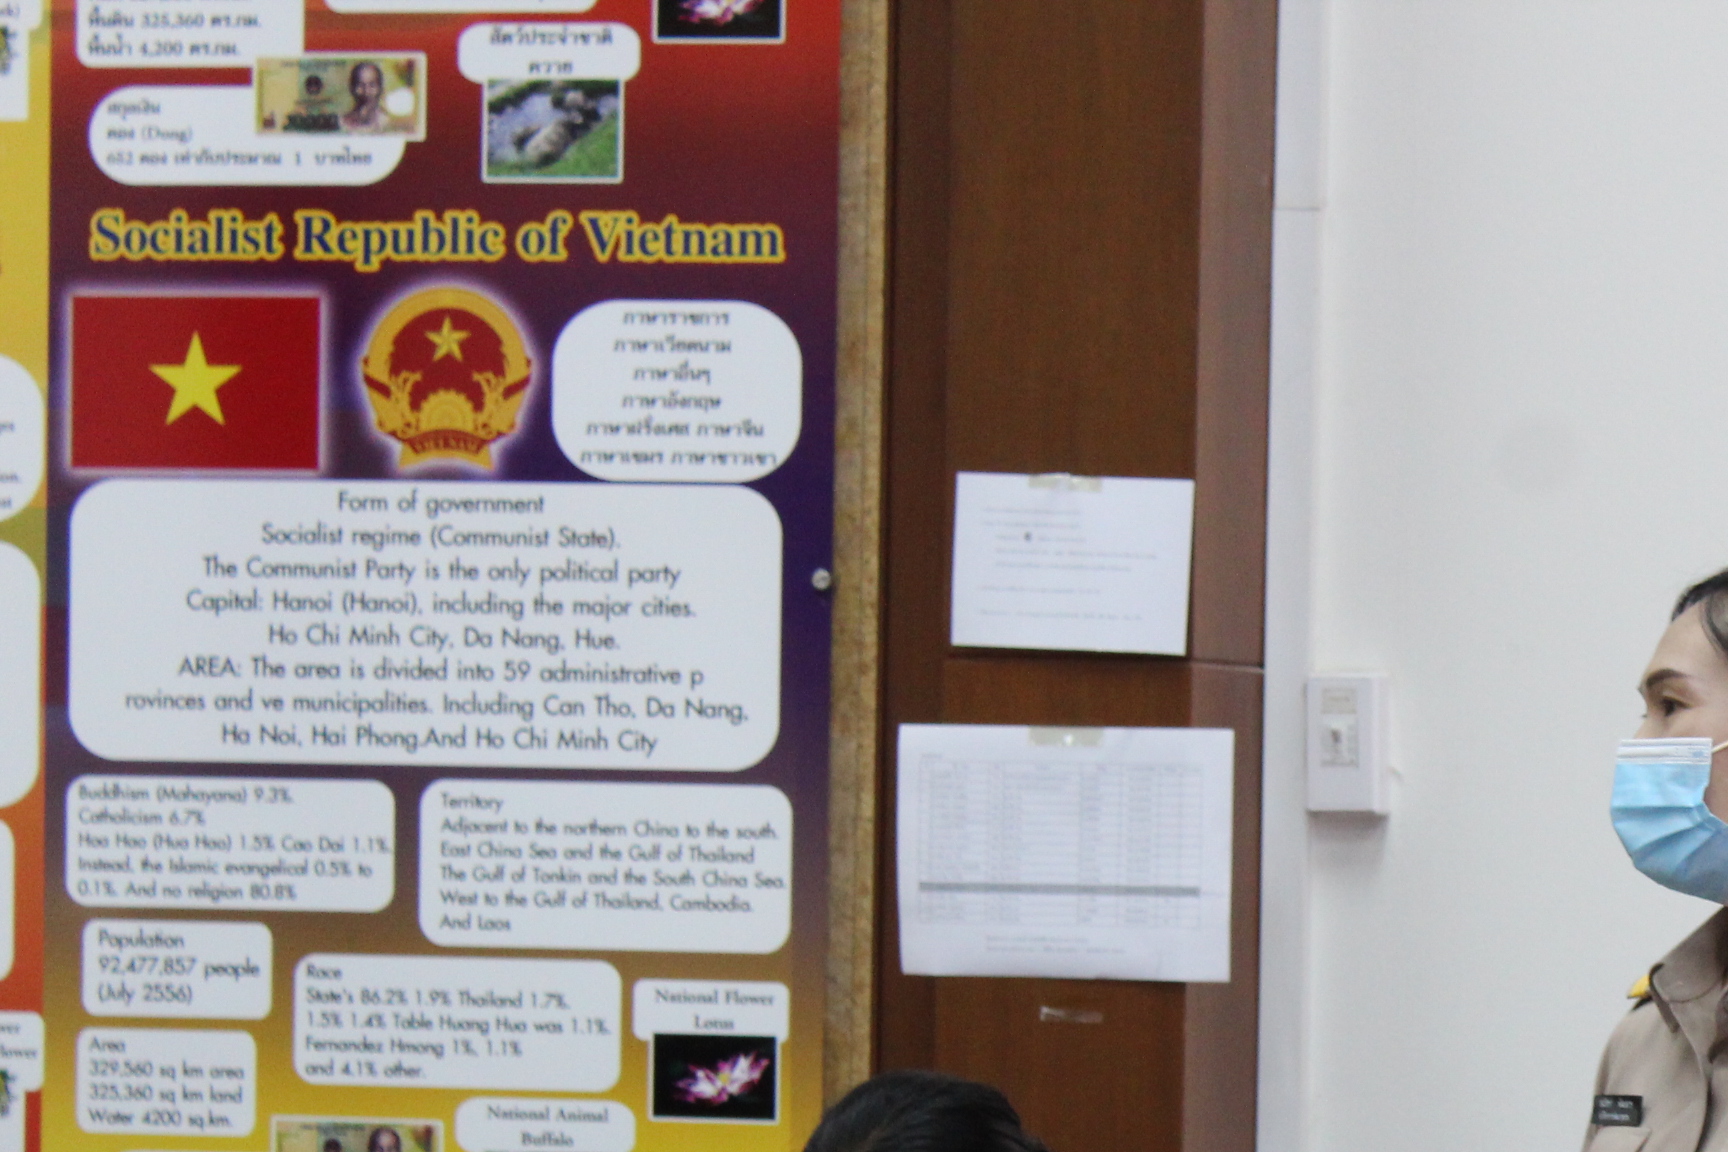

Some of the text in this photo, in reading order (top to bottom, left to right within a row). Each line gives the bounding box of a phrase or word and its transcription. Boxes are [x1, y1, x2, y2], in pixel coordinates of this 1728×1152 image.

[92, 209, 783, 269] Socialist Republic of Vietnam
[337, 489, 545, 520] Form of government
[261, 522, 620, 552] Socialist regime (Communist State).
[203, 554, 681, 589] The Communist Party is the only political party
[186, 587, 262, 617] Capital:
[272, 590, 333, 613] Hanoi
[432, 590, 525, 622] including
[533, 591, 564, 616] the
[572, 595, 632, 622] major
[640, 596, 695, 618] cities.
[268, 624, 298, 645] Ho
[305, 622, 340, 646] Chi
[348, 623, 400, 646] Minh
[463, 625, 493, 648] Da
[575, 628, 619, 650] Hue.
[178, 654, 704, 689] AREA: The area is divided into 59 administrative p
[125, 689, 206, 711] rovinces
[213, 687, 253, 712] and
[261, 696, 284, 712] ve
[292, 689, 432, 719] municipalities.
[443, 690, 535, 723] Including
[542, 693, 585, 717] Can
[646, 695, 675, 718] Da
[222, 723, 251, 745] Ha
[311, 725, 346, 746] Hai
[475, 727, 505, 749] Ho
[513, 726, 548, 750] Chi
[556, 727, 609, 750] Minh
[617, 729, 658, 758] City
[78, 783, 248, 805] Buddhism (Mahayana)
[441, 792, 504, 814] Territory
[78, 807, 163, 825] Catholicism
[441, 816, 729, 839] Adjacent to the northern China to the
[440, 840, 755, 864] East China Sea and the Gulf of Thailand
[140, 856, 163, 873] the
[169, 856, 218, 875] Islamic
[224, 858, 309, 881] evangelical
[357, 863, 373, 878] to
[440, 864, 467, 882] The
[472, 865, 505, 883] Gulf
[511, 865, 526, 883] of
[533, 866, 582, 884] Tonkin
[587, 867, 618, 885] and
[623, 868, 647, 886] the
[653, 869, 695, 887] South
[701, 869, 748, 888] China
[125, 880, 243, 905] And no religion
[440, 890, 479, 906] West
[483, 892, 499, 907] to
[504, 889, 528, 907] the
[533, 890, 567, 908] Gulf
[571, 890, 588, 909] of
[439, 913, 511, 931] And Laos
[98, 929, 185, 952] Population
[204, 957, 260, 981] people
[306, 963, 342, 980] Race
[97, 982, 193, 1006] (July 2556)
[416, 989, 452, 1007] 1.9%
[458, 989, 523, 1009] Thailand
[655, 989, 774, 1004] National Flower
[393, 1012, 564, 1035] Table Huang Hua was
[694, 1014, 734, 1031] Lotus
[89, 1037, 126, 1053] Area
[305, 1035, 445, 1059] Fernandez Hmong
[159, 1066, 177, 1082] sq
[182, 1060, 204, 1078] km
[209, 1067, 245, 1080] area
[305, 1058, 334, 1076] and
[159, 1090, 176, 1106] sq
[181, 1084, 203, 1102] km
[209, 1085, 243, 1104] land
[88, 1108, 182, 1126] Water 4200
[487, 1105, 609, 1123] National Animal
[521, 1131, 574, 1147] Buffalo
